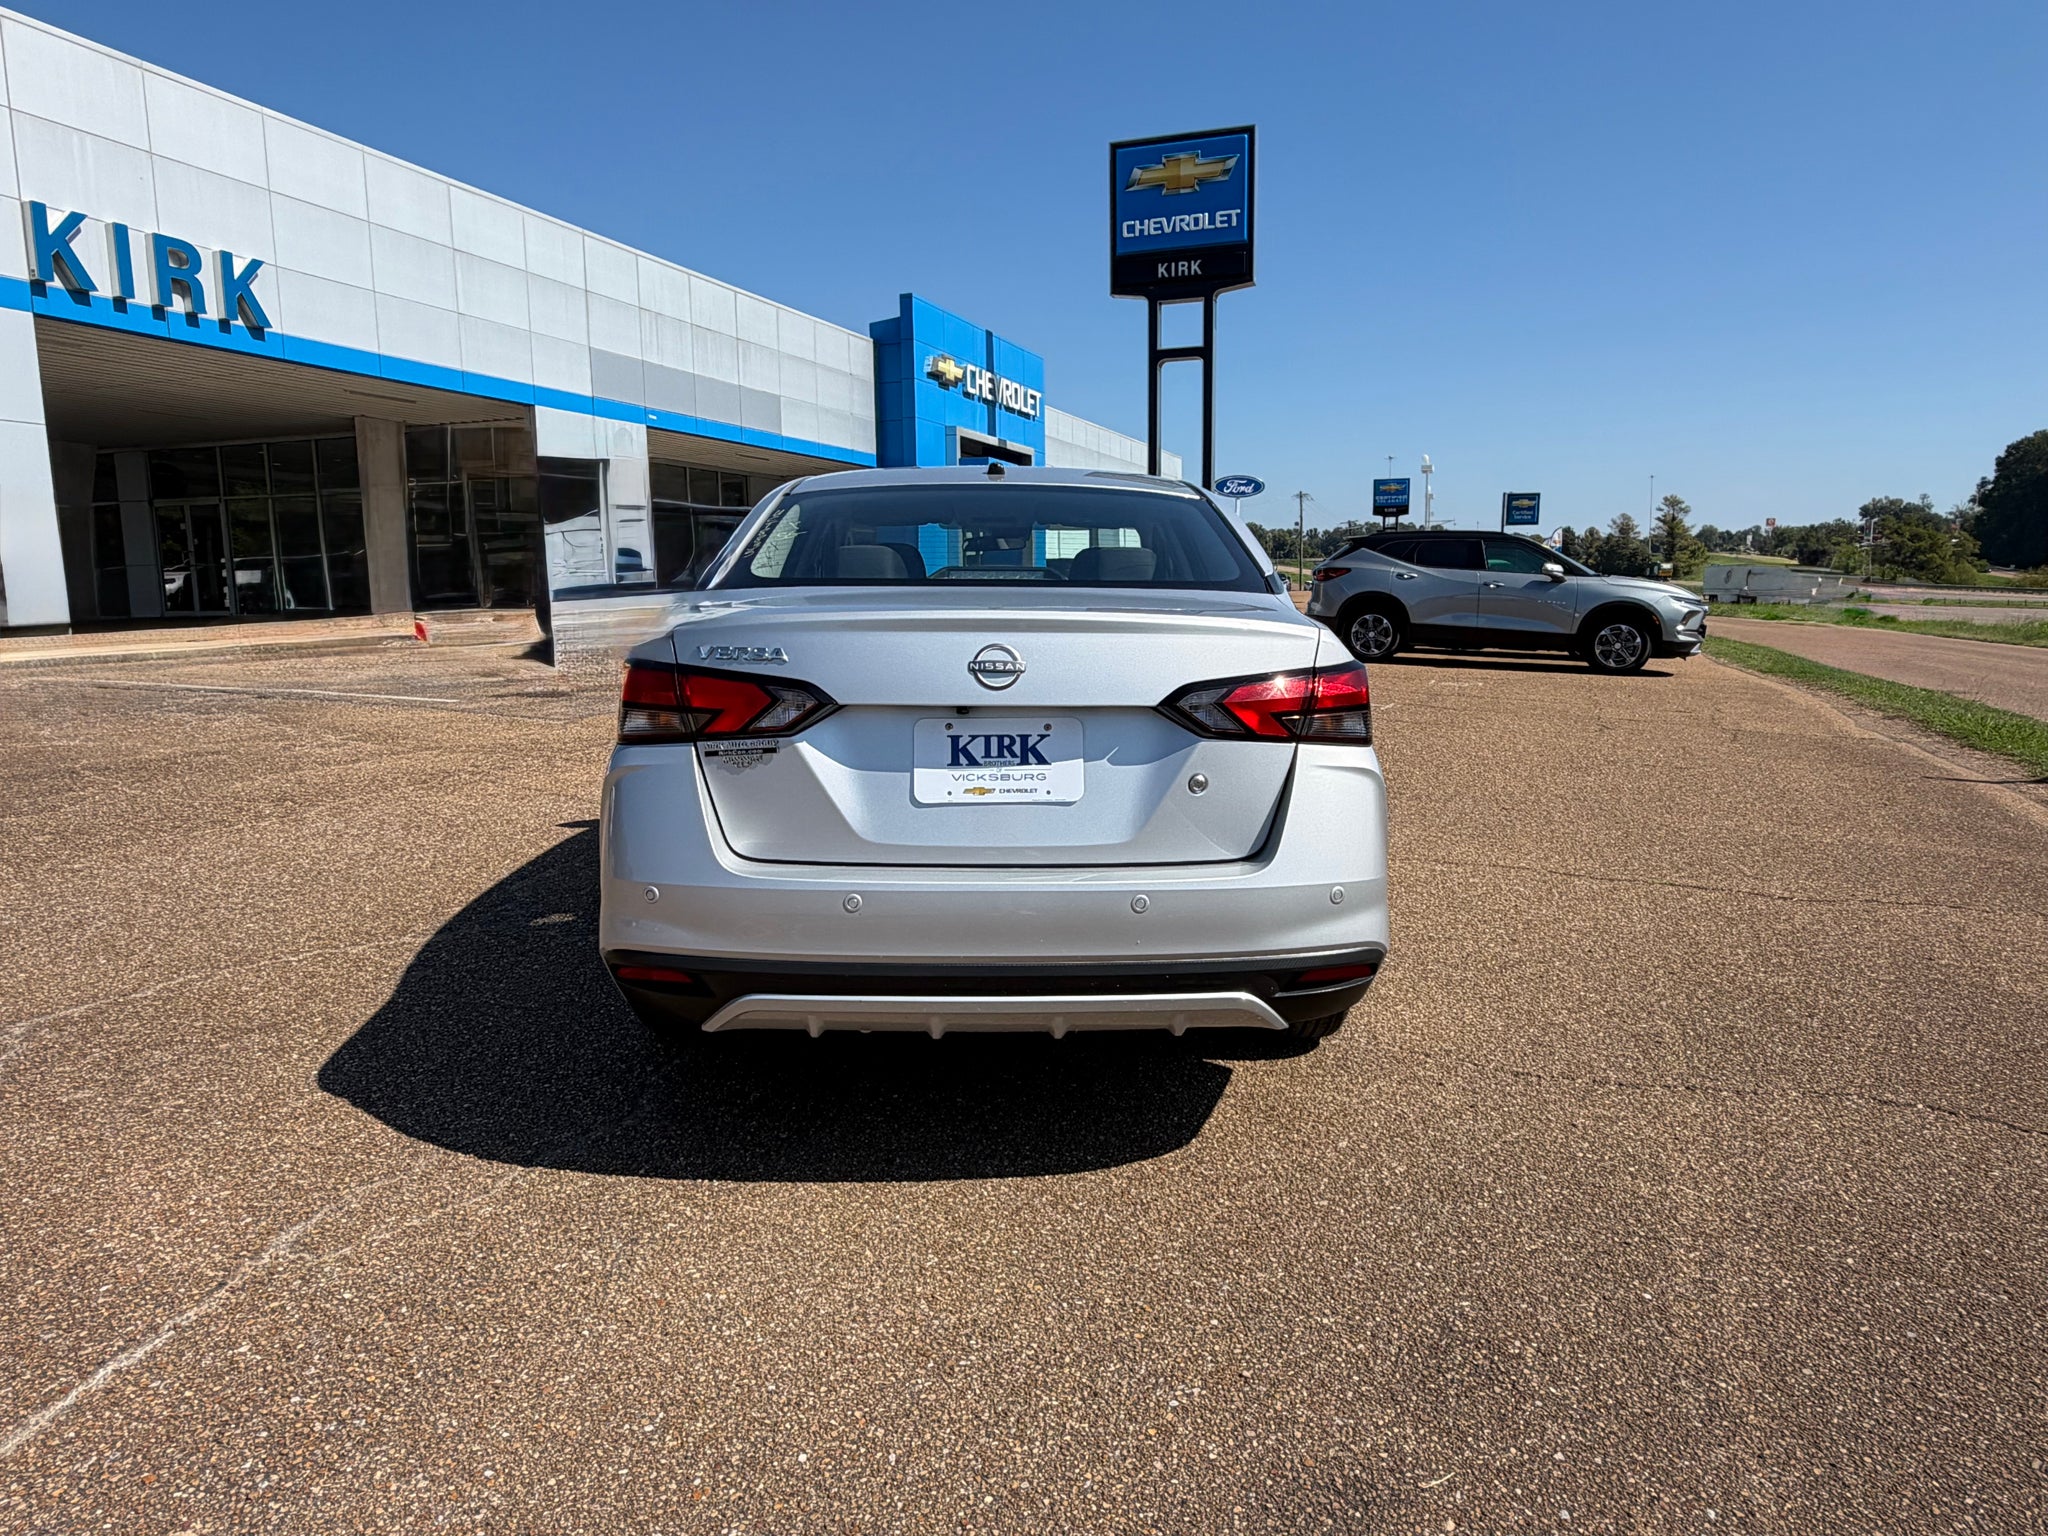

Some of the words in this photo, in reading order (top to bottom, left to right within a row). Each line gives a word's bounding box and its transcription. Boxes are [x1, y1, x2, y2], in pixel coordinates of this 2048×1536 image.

[1122, 209, 1241, 238] CHEVROLET
[22, 200, 273, 329] KIRK
[1157, 259, 1203, 278] KIRK
[966, 363, 1042, 417] CHEVROLET
[1223, 479, 1255, 493] Ford
[697, 646, 788, 663] VERSA
[969, 662, 1025, 671] NISSAN
[946, 734, 1052, 767] KIRK
[951, 773, 1047, 782] VICKSBURG
